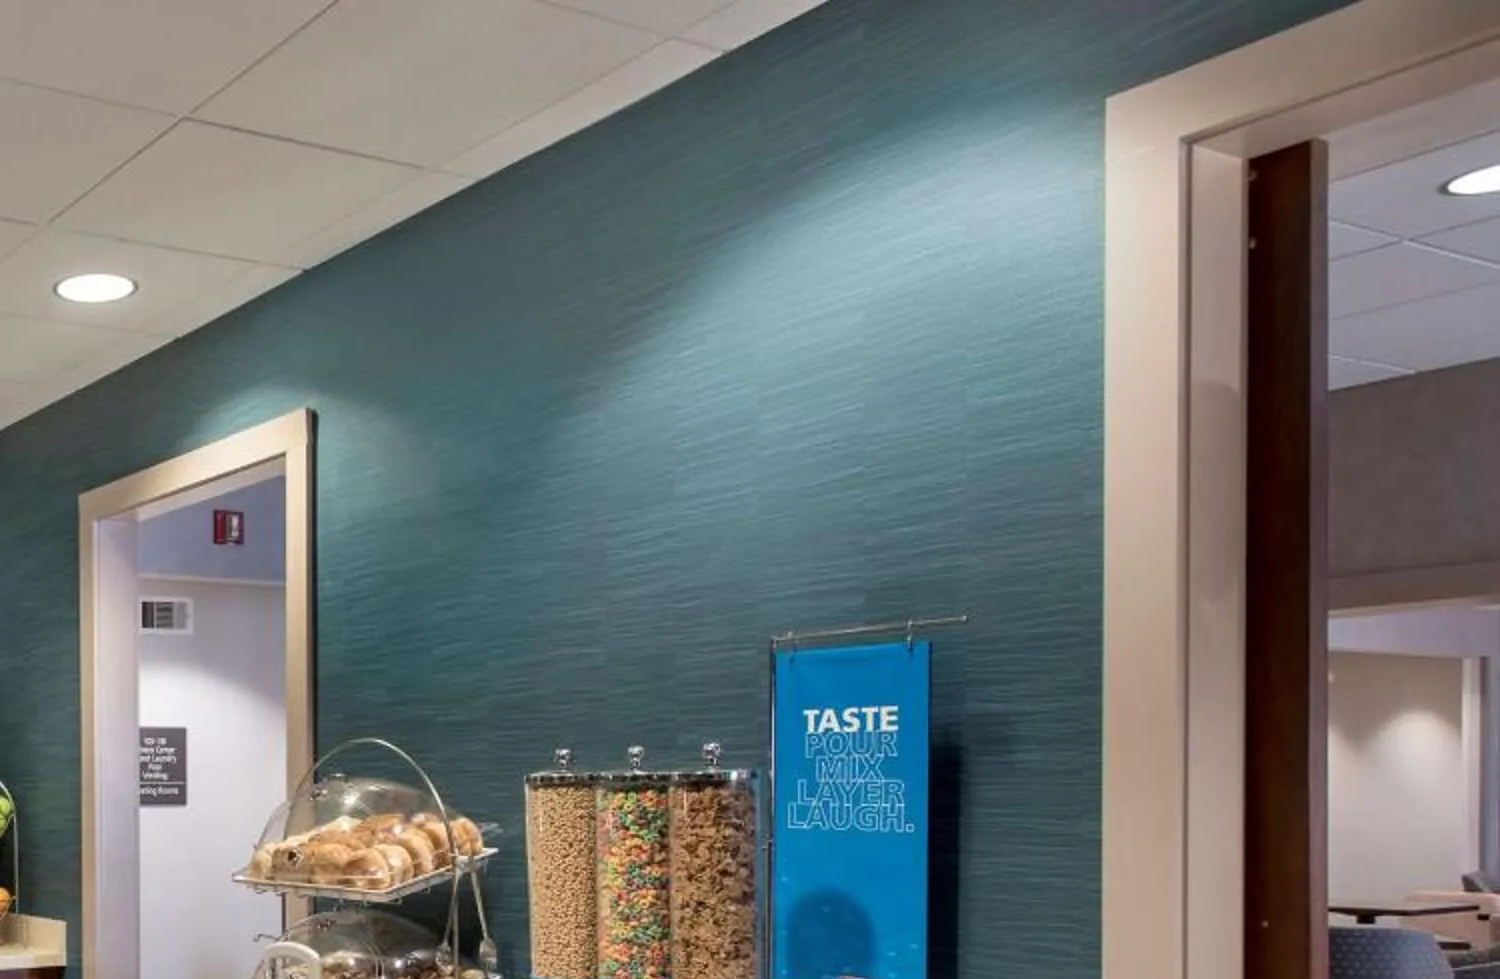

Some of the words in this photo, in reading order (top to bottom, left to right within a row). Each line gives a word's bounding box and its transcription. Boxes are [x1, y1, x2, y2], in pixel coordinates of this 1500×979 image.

[803, 705, 899, 733] TASTE
[805, 731, 898, 758] POUR
[816, 755, 884, 782] MIX
[797, 778, 905, 806] LAYER
[787, 802, 915, 833] LAUGH.
